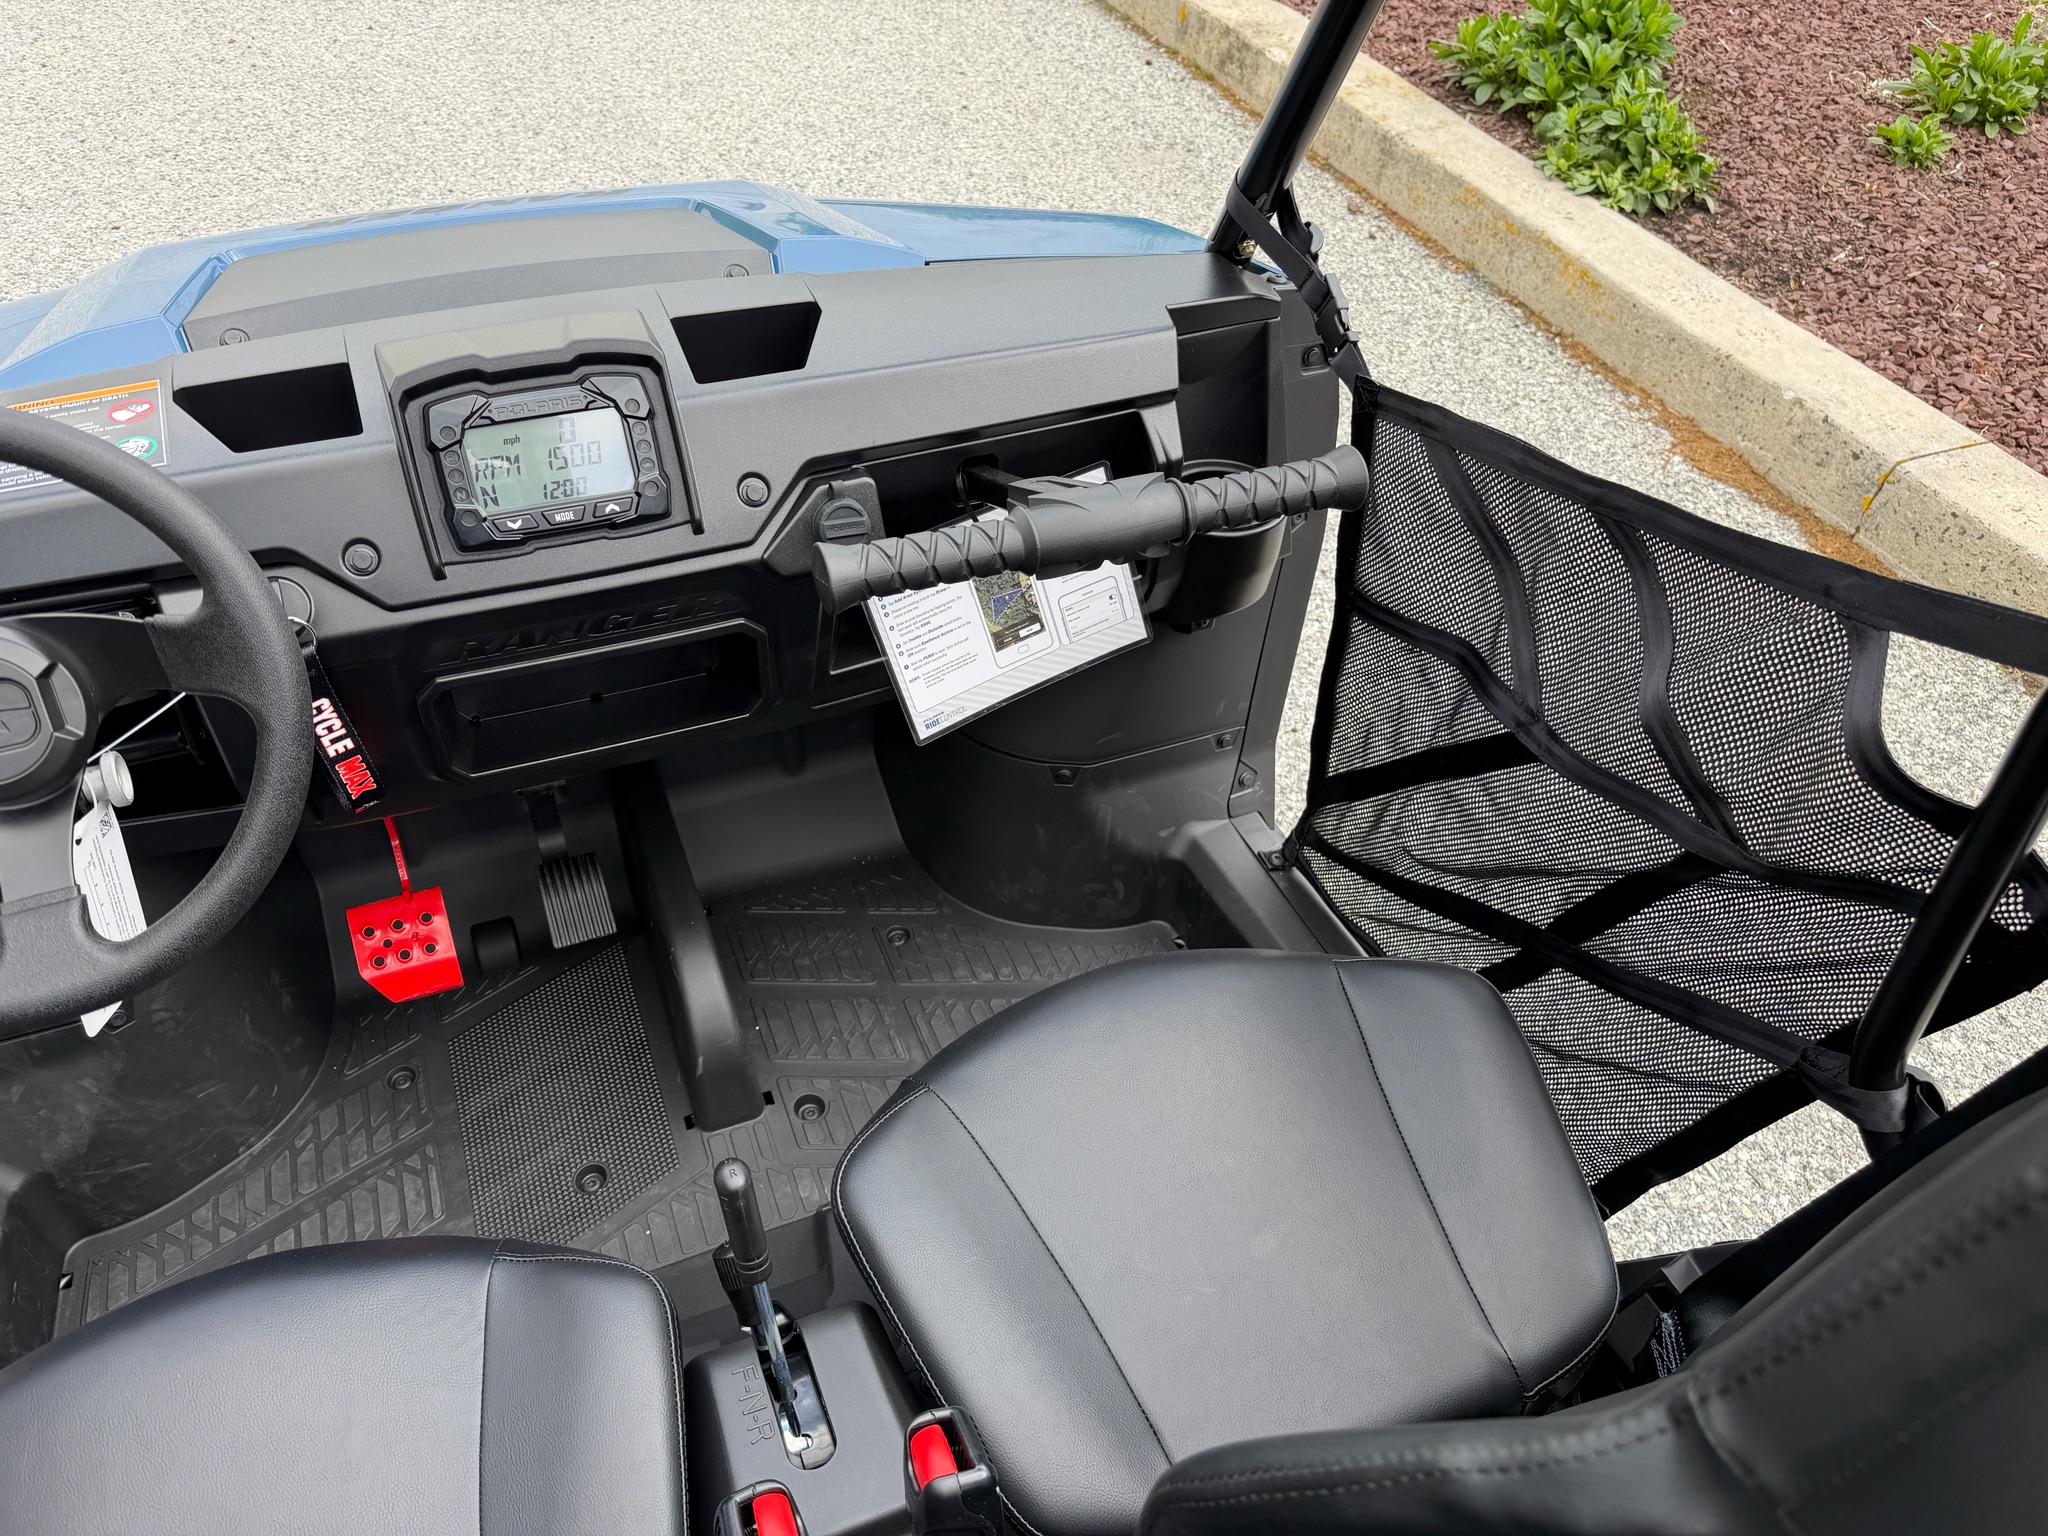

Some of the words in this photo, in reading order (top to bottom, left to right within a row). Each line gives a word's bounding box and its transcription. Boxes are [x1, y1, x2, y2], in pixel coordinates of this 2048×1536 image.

[494, 395, 582, 417] POLARIS
[503, 434, 520, 446] mph
[558, 417, 577, 443] 0
[474, 453, 521, 482] RPM
[548, 441, 602, 471] 1500
[480, 484, 499, 509] N
[554, 511, 575, 522] MODE
[439, 598, 723, 667] RANGER
[312, 697, 356, 759] CYCLE
[335, 754, 377, 800] MAX
